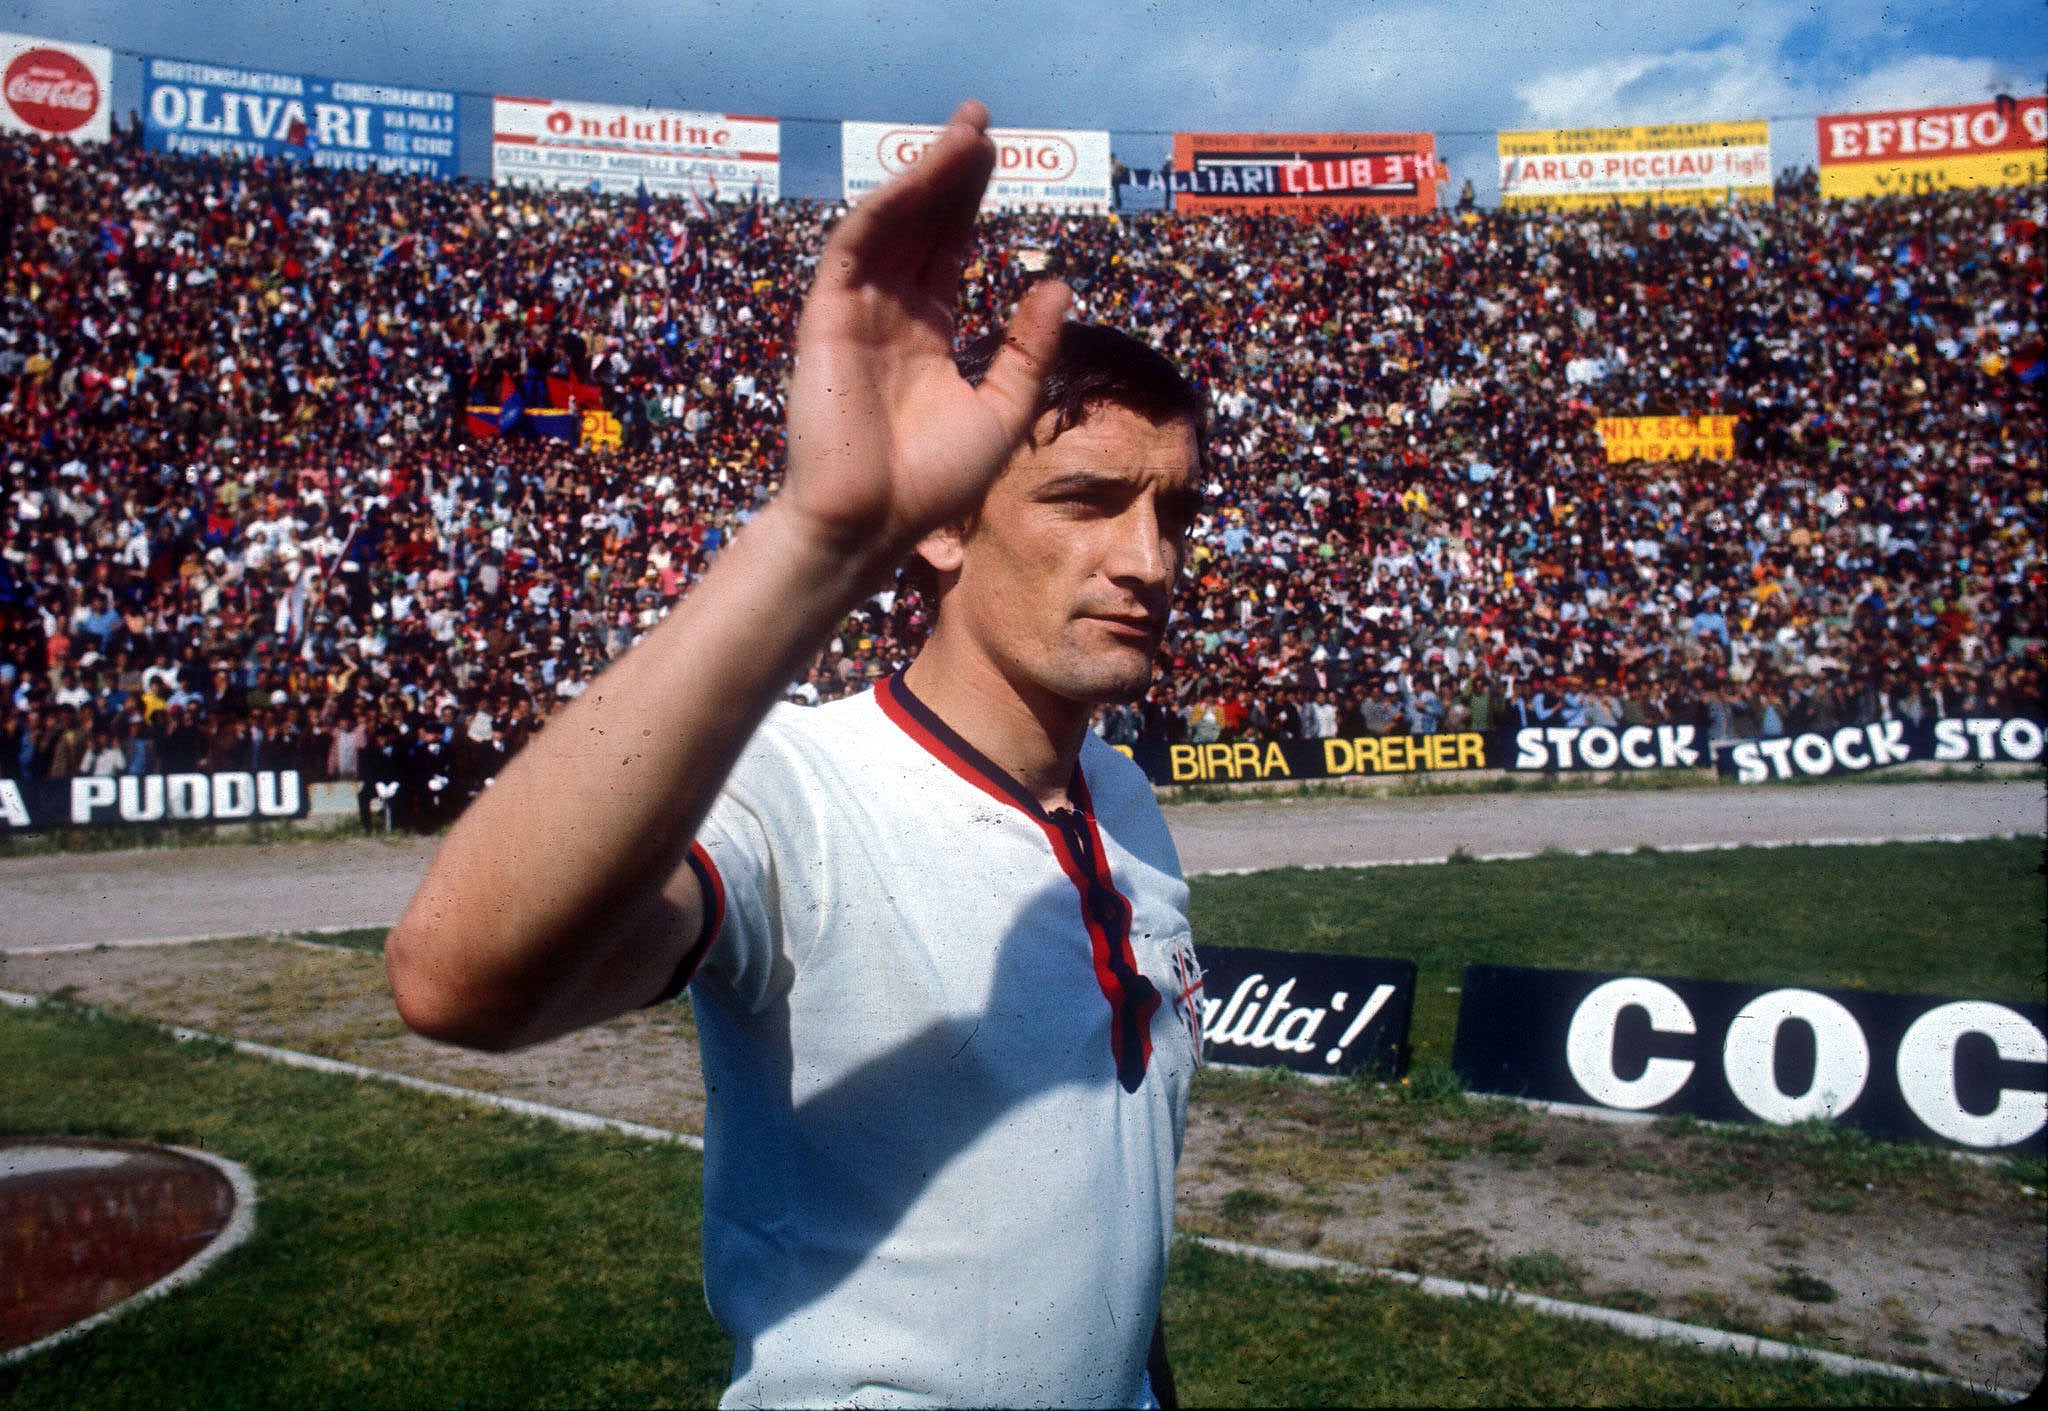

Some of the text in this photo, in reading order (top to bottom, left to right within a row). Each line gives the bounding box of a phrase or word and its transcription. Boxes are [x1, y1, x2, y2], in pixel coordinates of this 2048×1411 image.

[151, 84, 372, 148] OLIVARI
[546, 110, 731, 146] Onduline
[1829, 111, 2009, 159] EFISIO
[896, 142, 1060, 170] GDIG
[1286, 157, 1372, 193] CLUB
[1502, 158, 1595, 186] ARLO
[1604, 151, 1714, 178] PICCIAU
[1170, 732, 1487, 782] BIRRA DREHER
[1516, 725, 1699, 769] STOCK
[1732, 720, 1911, 784] STOCK
[1934, 718, 2048, 760] STO
